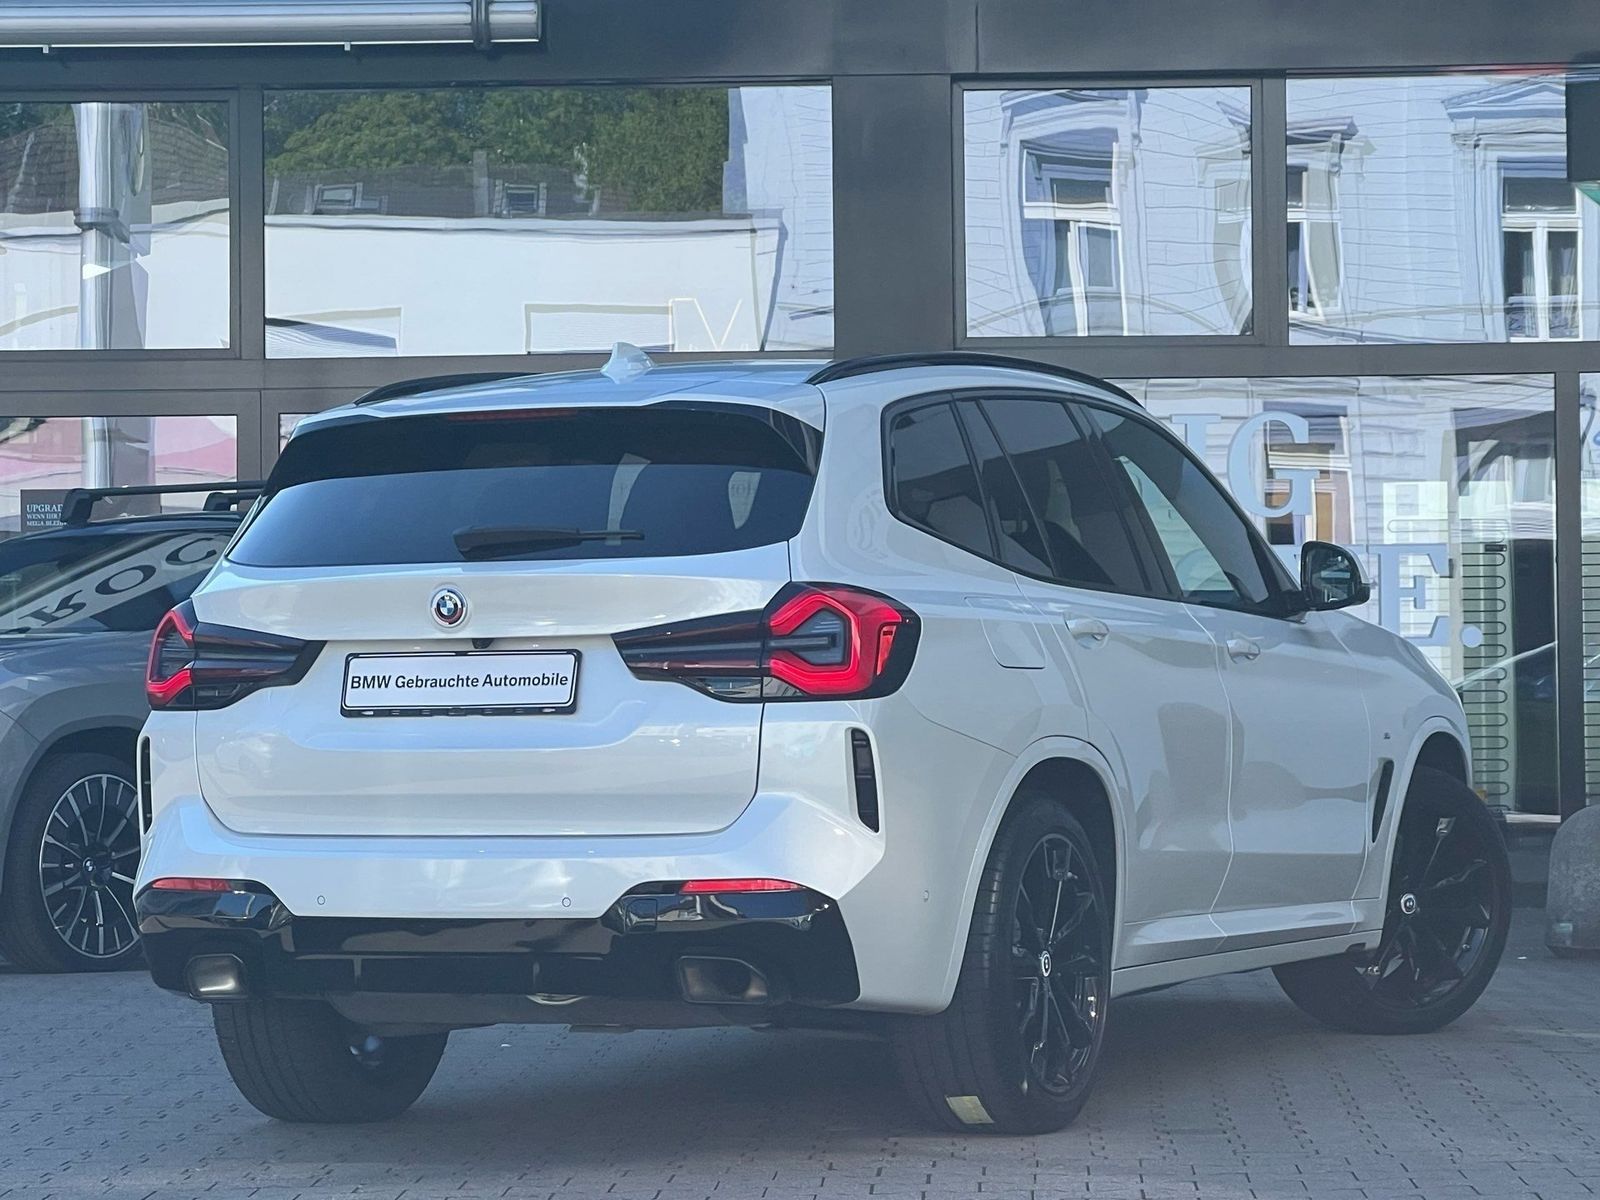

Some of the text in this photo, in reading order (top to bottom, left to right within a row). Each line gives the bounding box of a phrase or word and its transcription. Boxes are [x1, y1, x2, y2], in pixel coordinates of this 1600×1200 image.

[350, 672, 569, 690] BMW Gebrauchte Automobile
